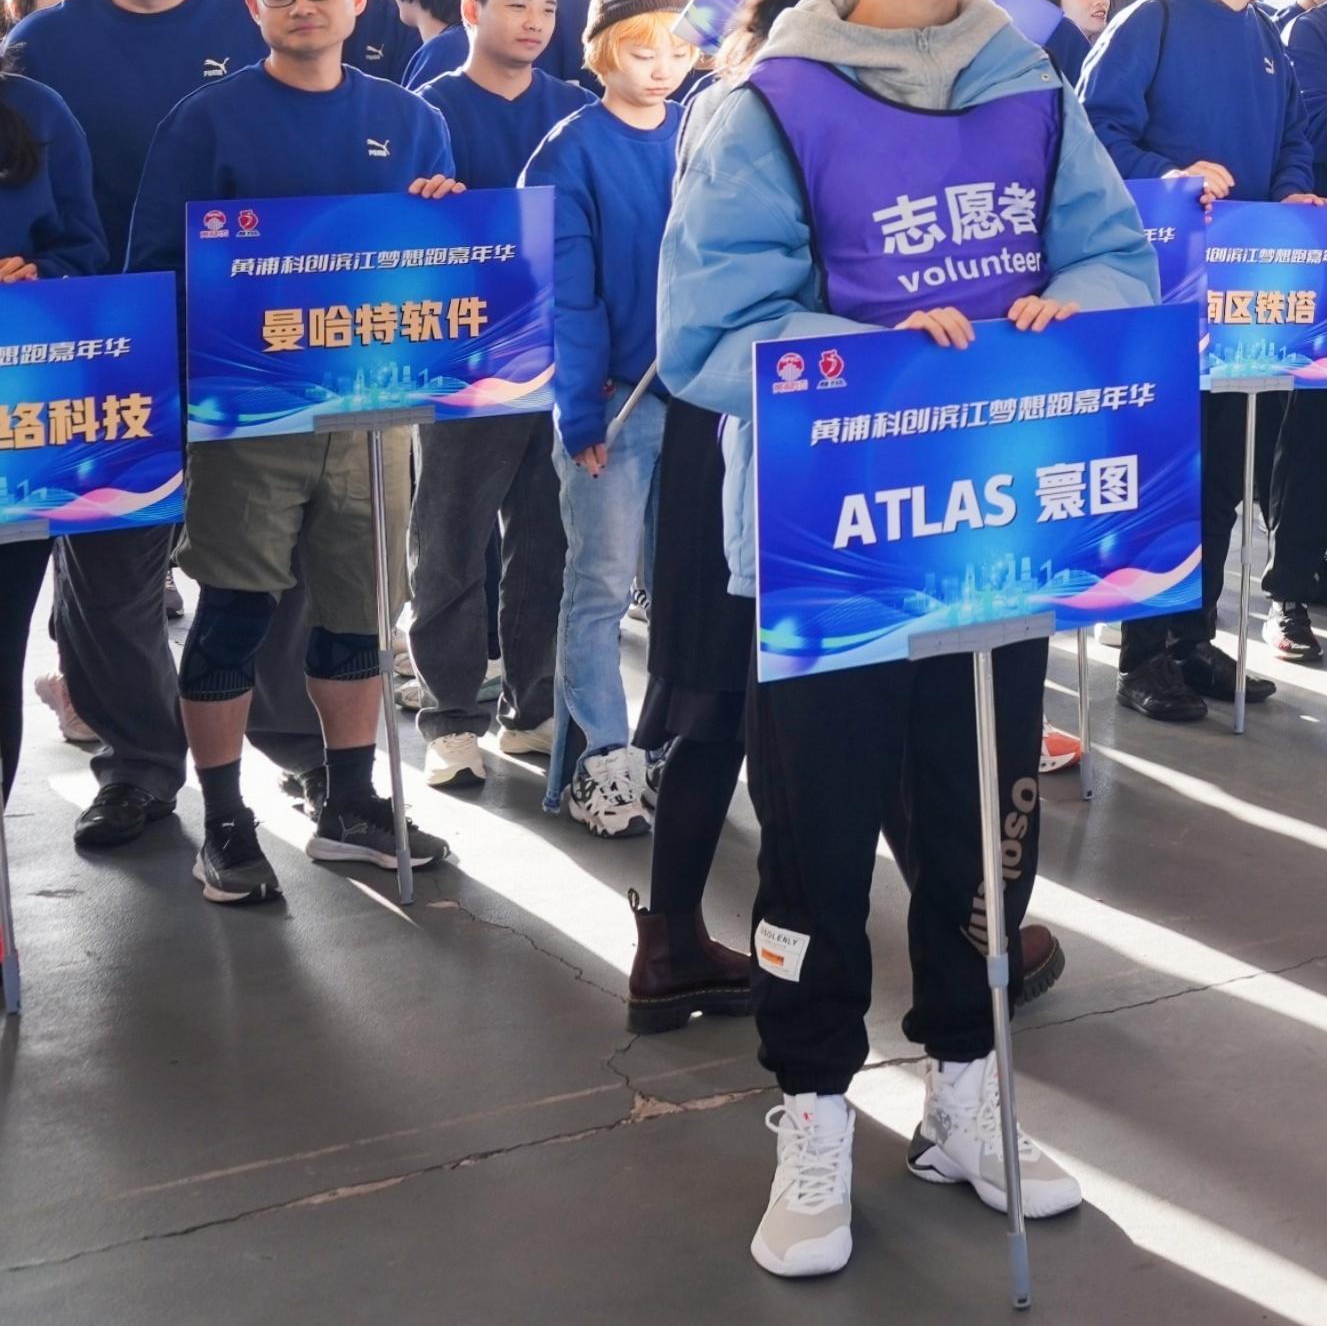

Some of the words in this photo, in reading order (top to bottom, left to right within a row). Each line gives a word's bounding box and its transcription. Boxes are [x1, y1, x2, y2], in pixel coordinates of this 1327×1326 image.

[873, 182, 1038, 255] 志愿者
[231, 243, 517, 278] 黄浦科创滨江梦想跑嘉年华
[898, 247, 1042, 293] volunteer
[262, 296, 489, 354] 曼哈特软件
[0, 392, 154, 450] 络科技
[810, 382, 1157, 447] 黄浦科创滨江梦想跑嘉年华
[833, 474, 1017, 550] ATLAS
[1036, 454, 1139, 525] 寰图
